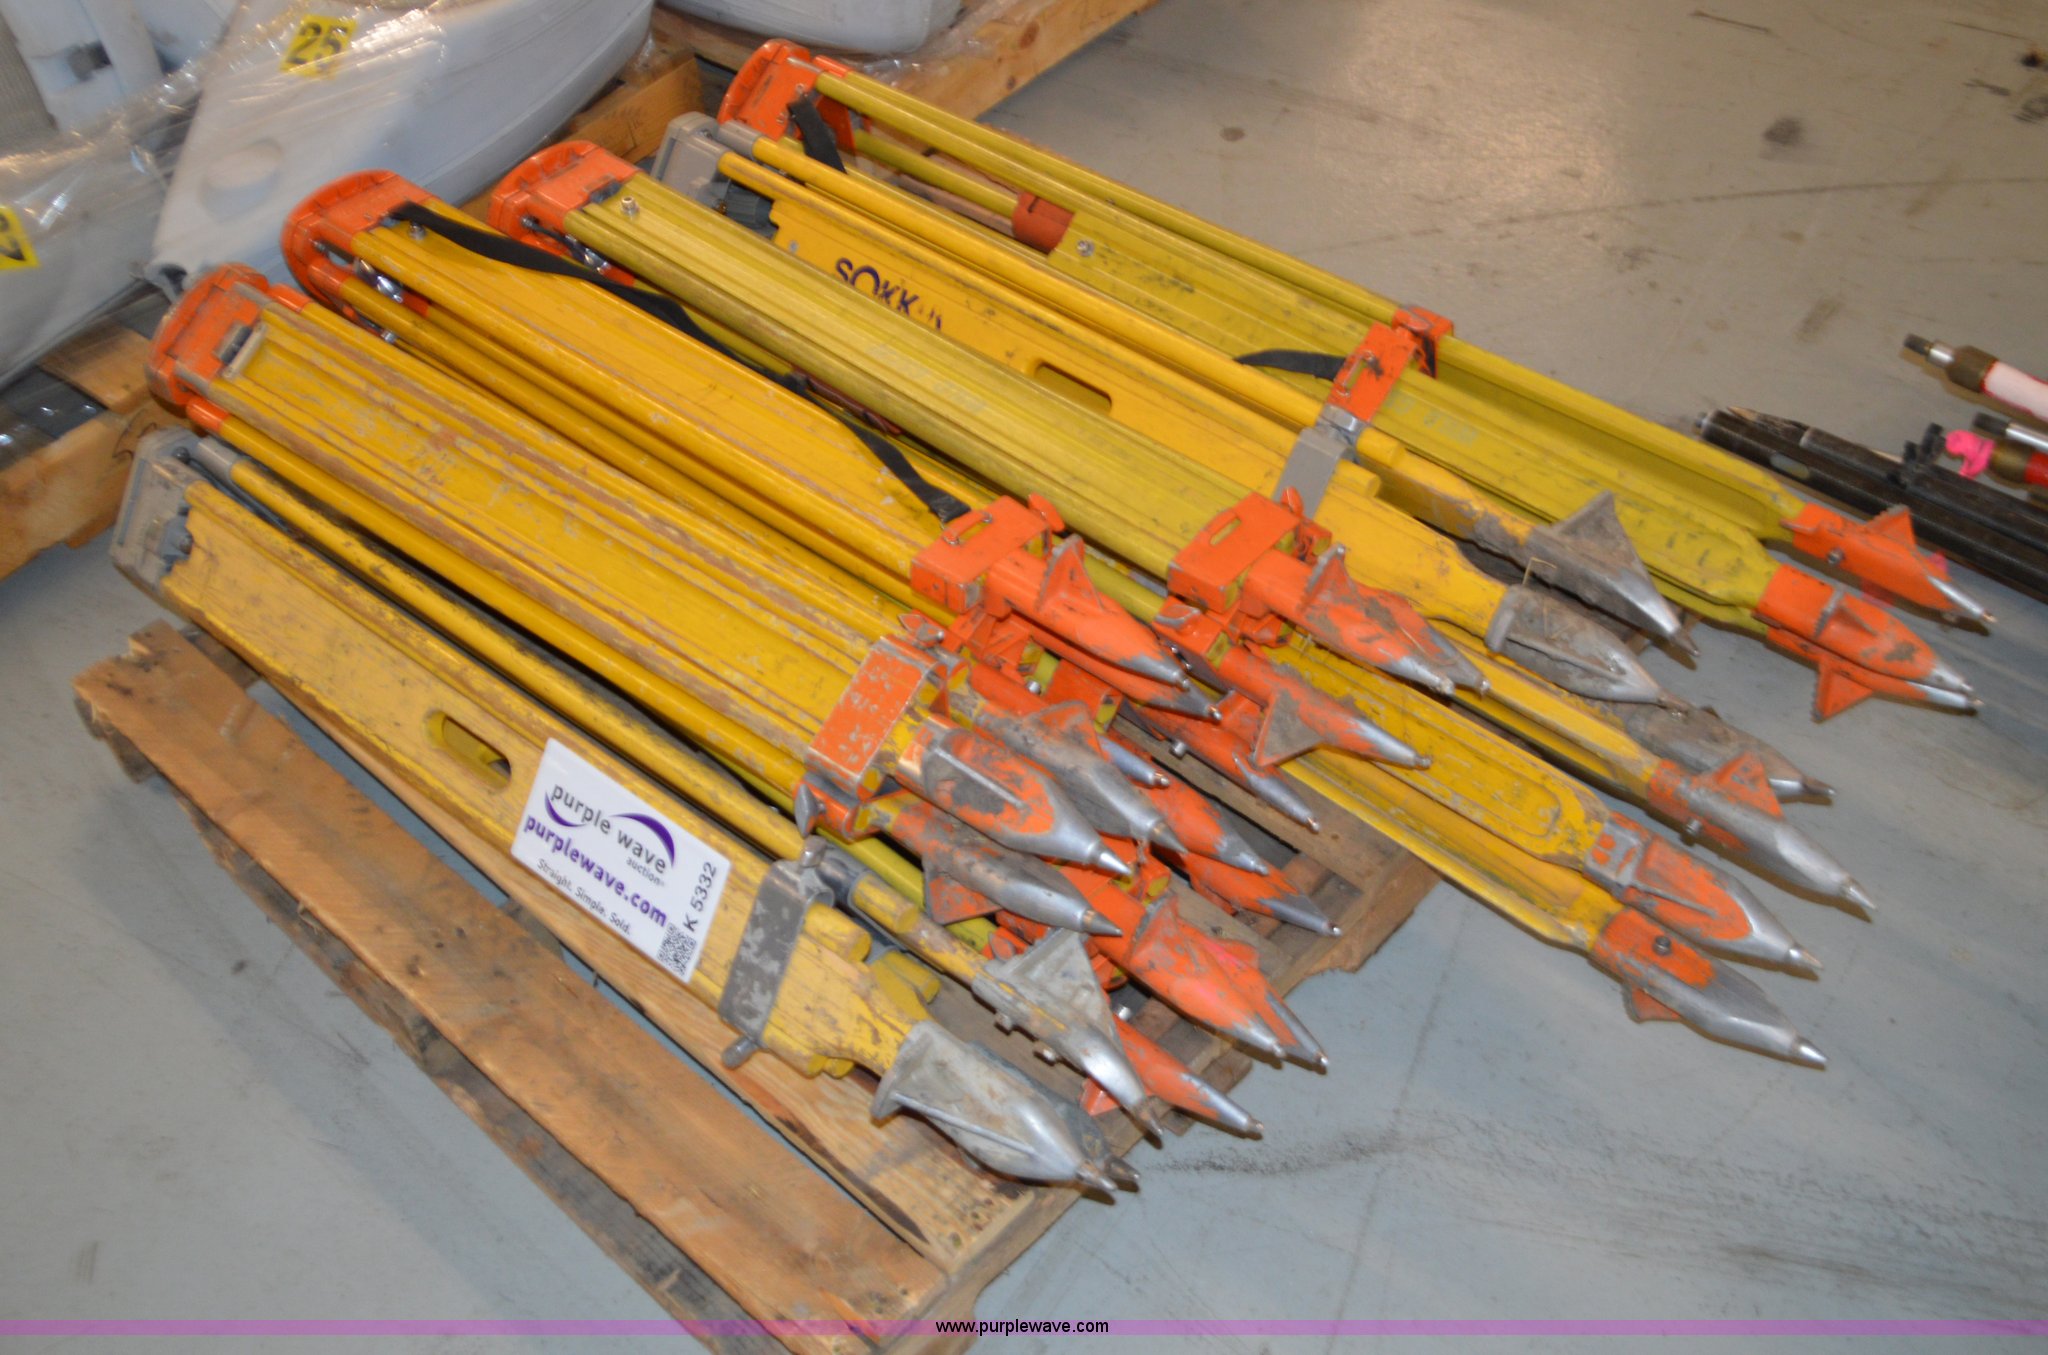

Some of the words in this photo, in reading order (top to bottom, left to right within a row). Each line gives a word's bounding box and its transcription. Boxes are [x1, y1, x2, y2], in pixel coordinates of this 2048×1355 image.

[285, 22, 348, 75] 25
[835, 257, 943, 331] SOKK
[551, 784, 612, 835] purple
[617, 829, 667, 875] wave
[524, 815, 668, 928] purplewave.com
[537, 858, 574, 893] Straight.
[574, 886, 607, 916] Simple.
[609, 912, 632, 936] Sold.
[626, 856, 662, 887] auction
[690, 861, 718, 913] 5332
[683, 913, 698, 933] K
